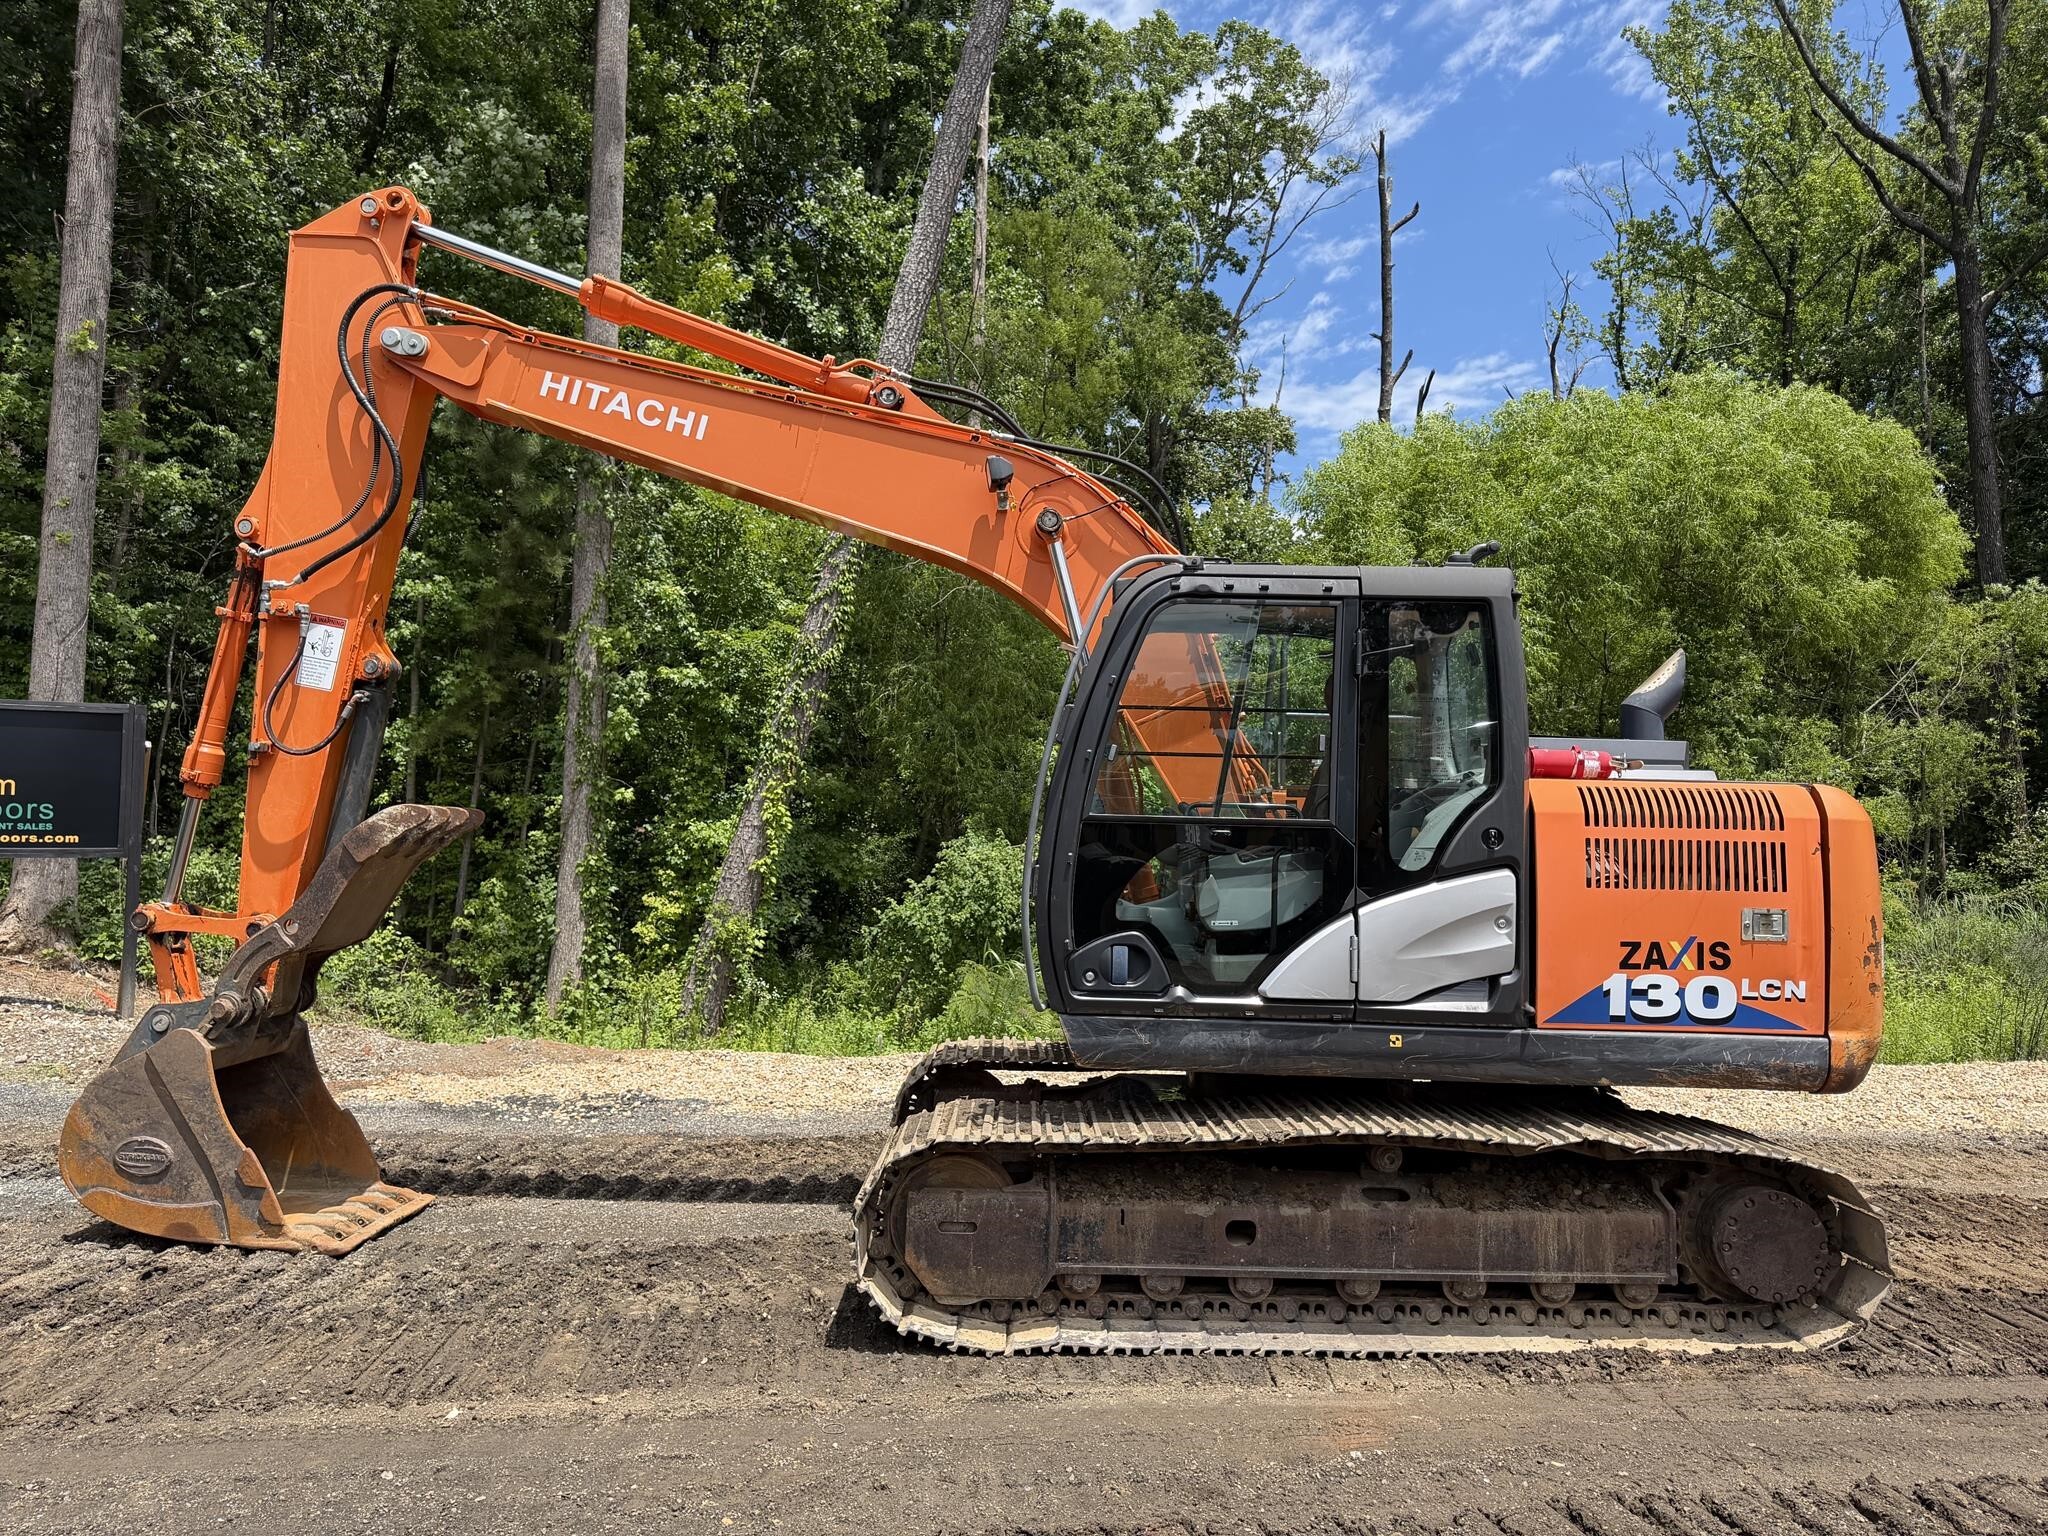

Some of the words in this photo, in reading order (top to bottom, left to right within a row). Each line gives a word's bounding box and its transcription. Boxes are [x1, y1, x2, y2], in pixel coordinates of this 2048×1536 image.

[539, 371, 709, 441] HITACHI
[319, 616, 345, 627] WARNING
[0, 803, 54, 820] ors
[17, 822, 53, 831] SALES
[0, 834, 79, 843] oors.com
[1619, 936, 1731, 971] ZAXIS
[1602, 973, 1738, 1023] 130
[1741, 978, 1807, 1002] LCN
